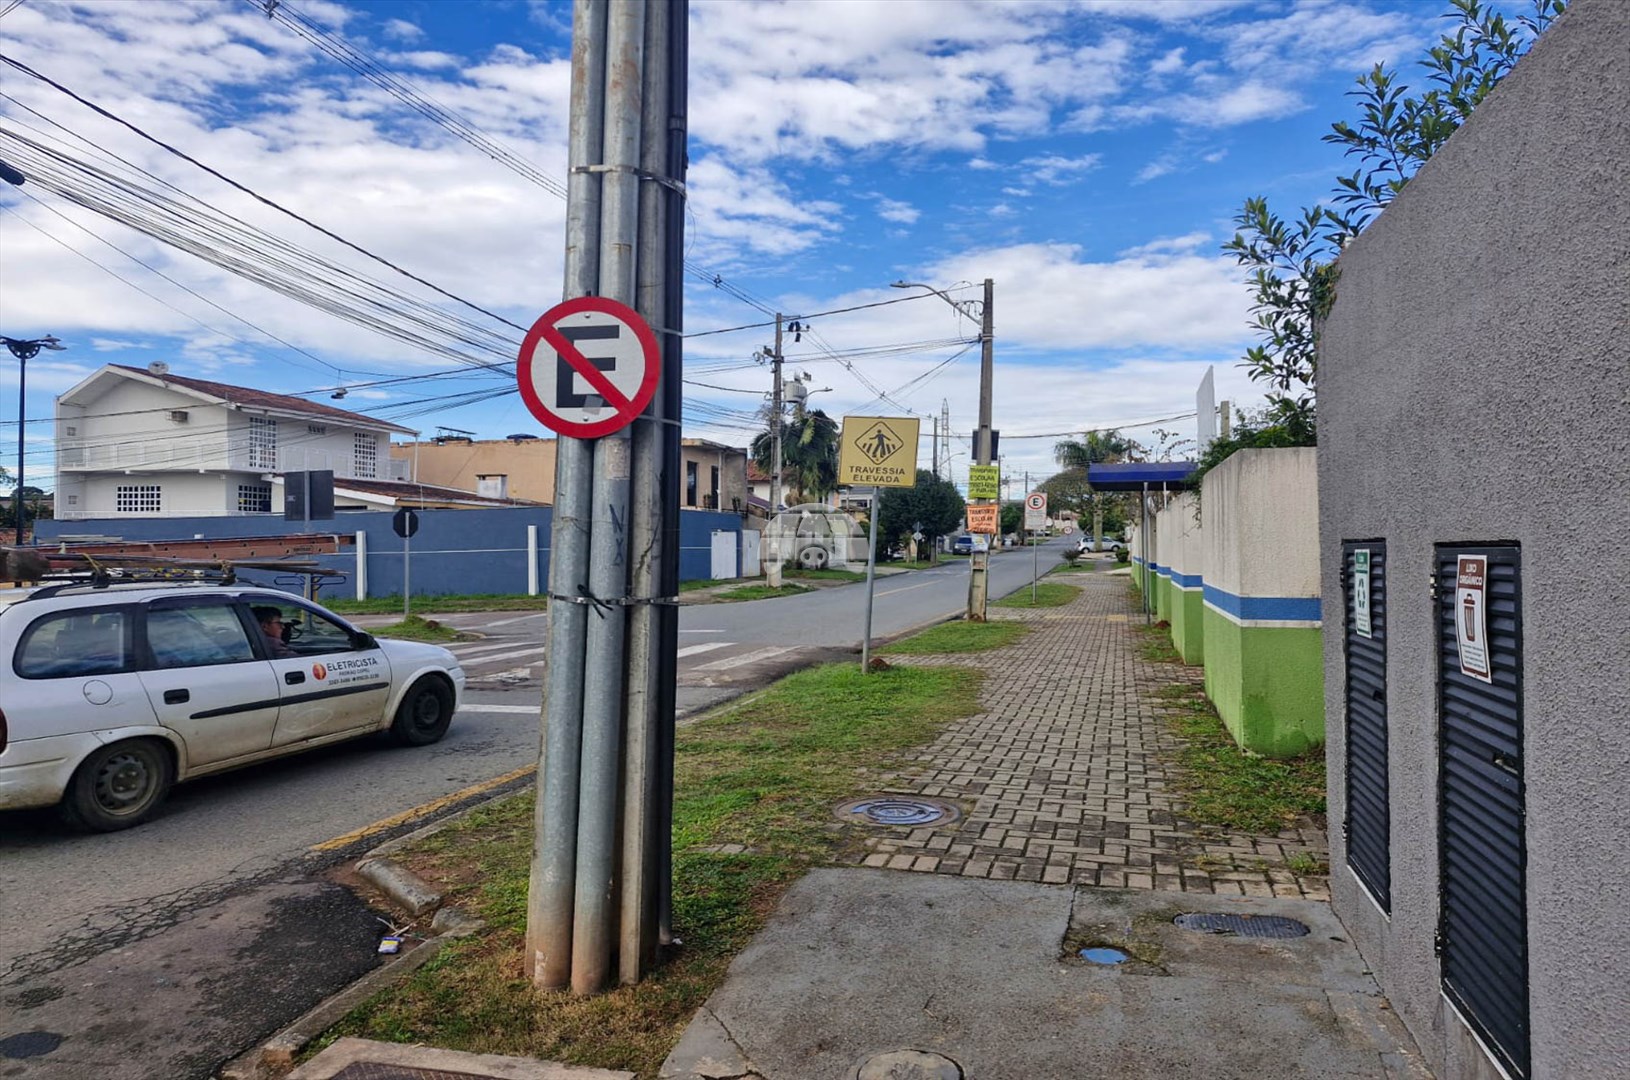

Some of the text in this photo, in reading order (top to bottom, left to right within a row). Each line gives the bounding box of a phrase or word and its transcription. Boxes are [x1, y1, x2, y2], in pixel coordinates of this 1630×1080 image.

[556, 325, 620, 408] E
[849, 465, 906, 475] TRAVESSIA
[853, 474, 900, 483] ELEVADA
[1032, 497, 1040, 507] E
[326, 657, 378, 671] ELETRICISTA
